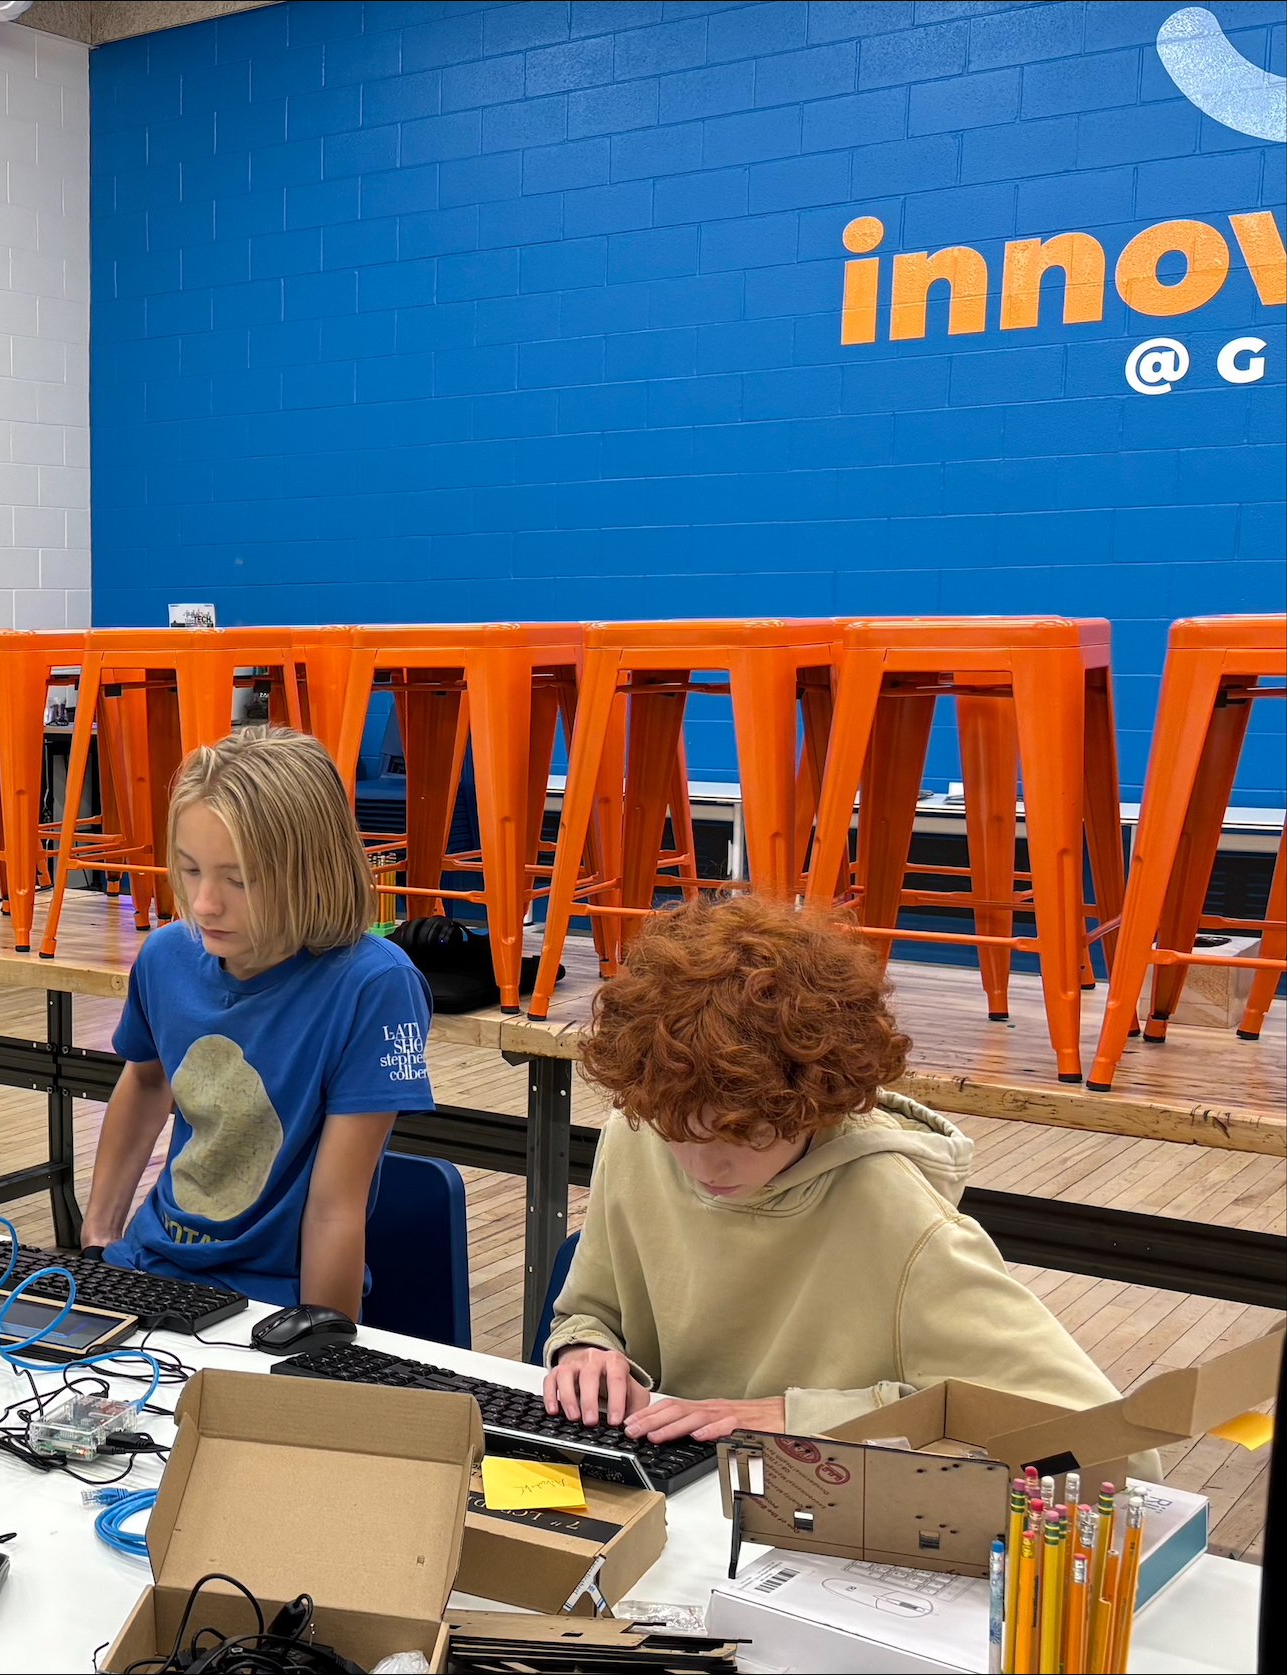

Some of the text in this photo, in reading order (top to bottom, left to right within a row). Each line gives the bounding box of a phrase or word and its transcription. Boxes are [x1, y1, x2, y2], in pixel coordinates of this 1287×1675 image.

[1125, 337, 1267, 395] @ G
[380, 1049, 425, 1070] stephe
